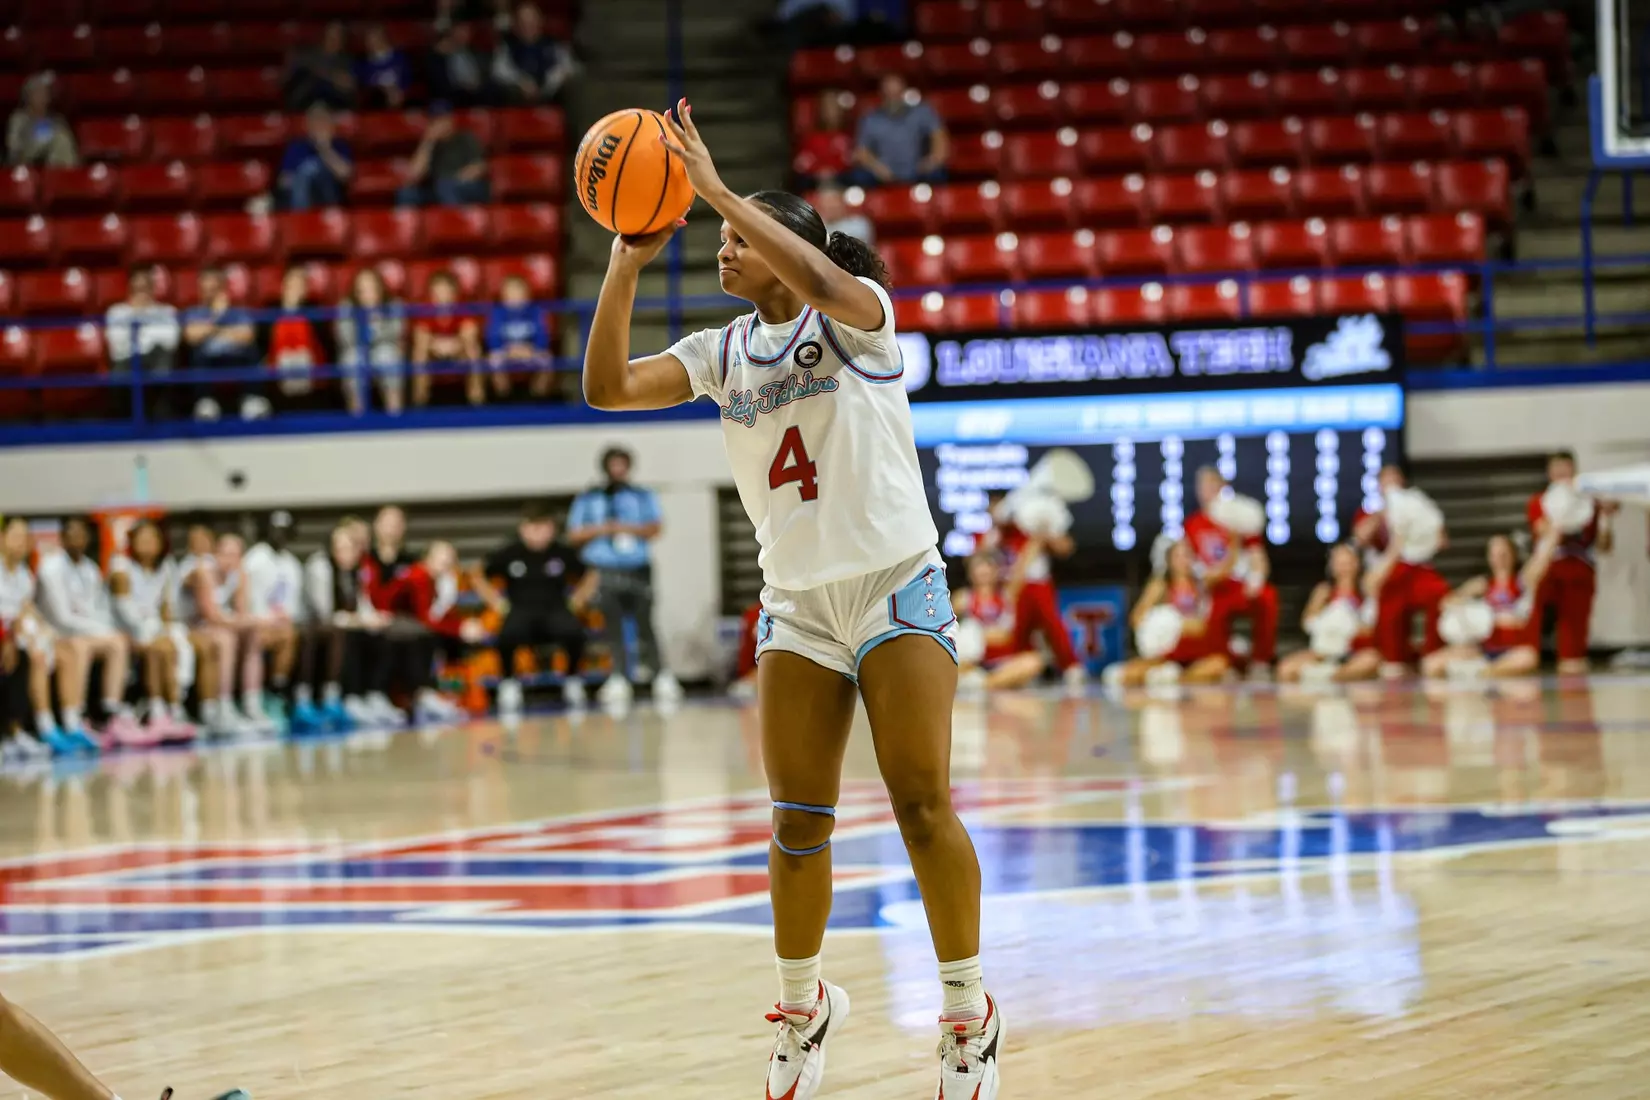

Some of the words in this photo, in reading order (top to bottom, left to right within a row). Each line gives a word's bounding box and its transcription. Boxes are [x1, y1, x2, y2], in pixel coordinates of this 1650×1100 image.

[586, 133, 622, 211] Wilson
[720, 389, 758, 428] Lady
[768, 425, 818, 502] 4
